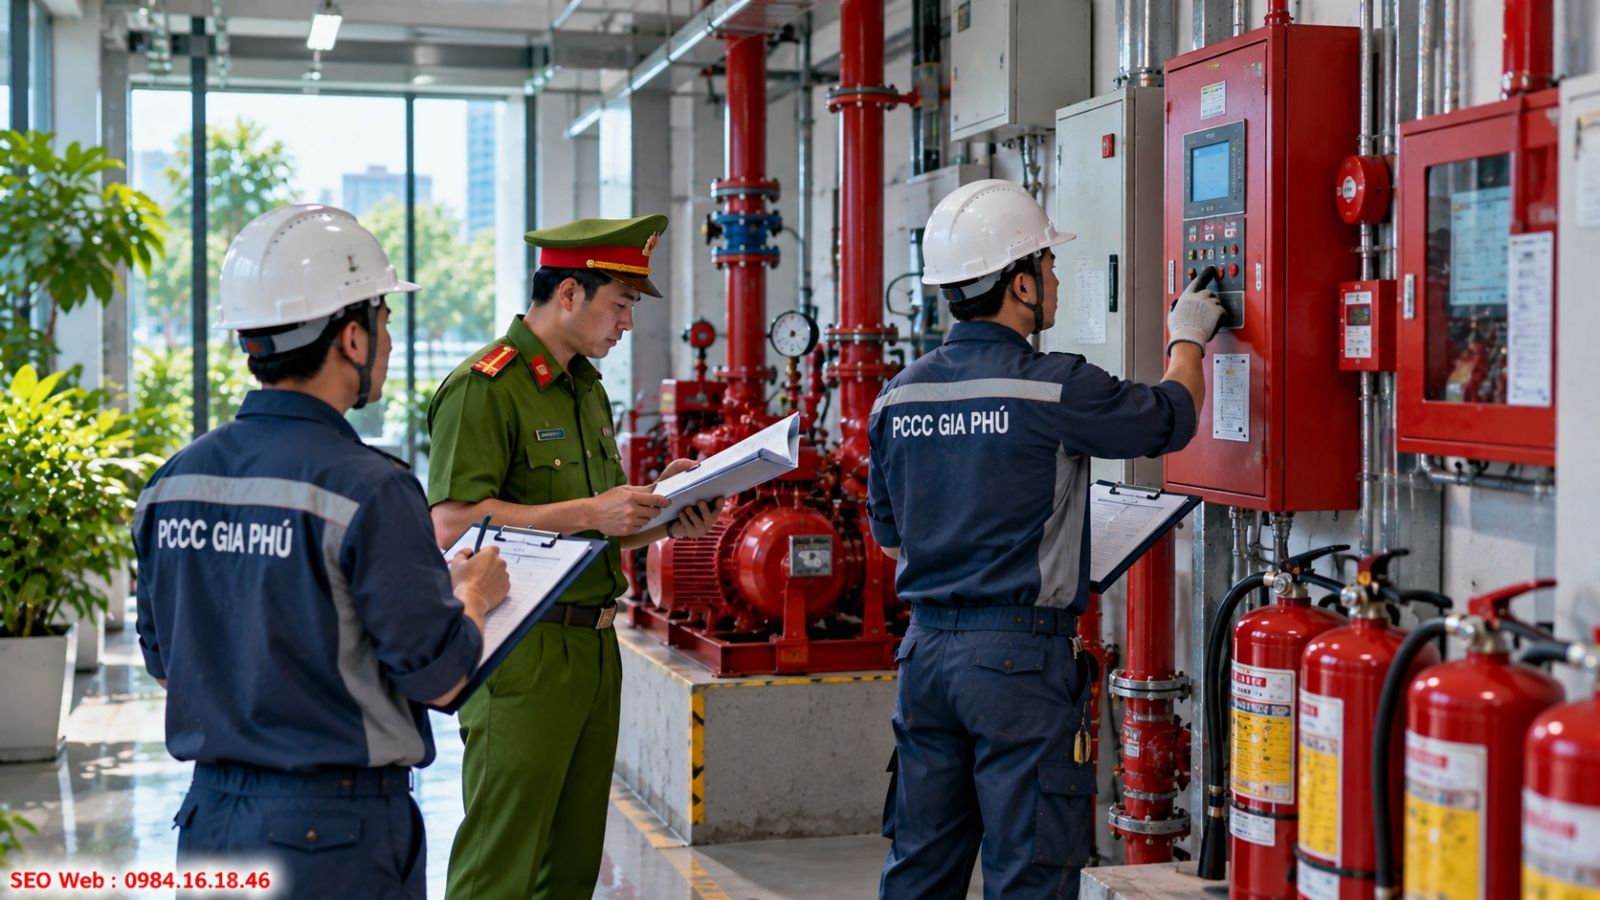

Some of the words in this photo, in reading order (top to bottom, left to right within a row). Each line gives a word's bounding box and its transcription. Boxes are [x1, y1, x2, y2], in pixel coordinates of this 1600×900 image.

[892, 414, 934, 439] PCCC
[938, 412, 967, 436] GIA
[970, 405, 1009, 434] PHÚ
[158, 518, 207, 550] PCCC
[212, 521, 245, 553] GIA
[248, 519, 293, 558] PHÚ
